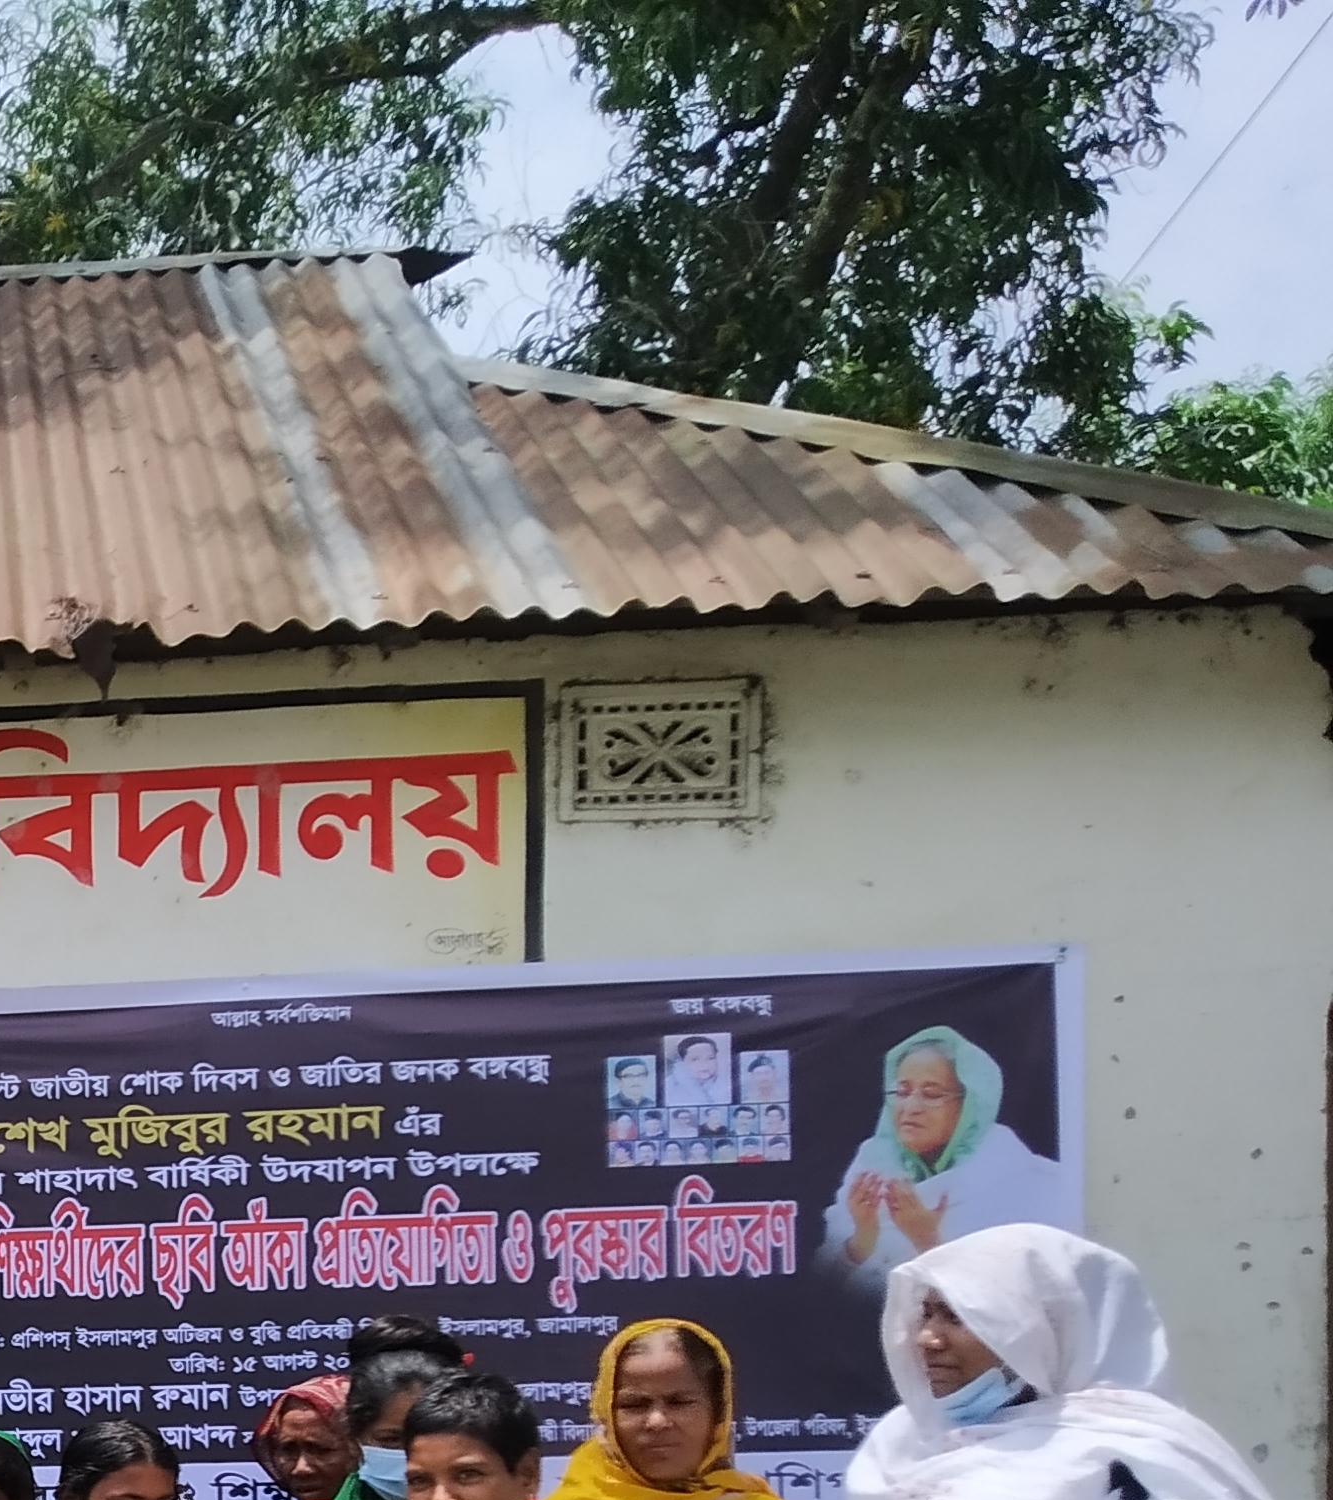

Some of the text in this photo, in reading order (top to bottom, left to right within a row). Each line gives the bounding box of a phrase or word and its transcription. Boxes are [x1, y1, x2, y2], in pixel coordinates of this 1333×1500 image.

[210, 1003, 352, 1028] আল্লাহ সর্বশক্তিমান
[669, 994, 773, 1017] জয় বঙ্গবন্ধু
[28, 1067, 111, 1100] জাতীয়
[119, 1068, 184, 1096] শোক
[191, 1062, 259, 1093] দিবস
[267, 1066, 291, 1088] ও
[298, 1055, 383, 1088] জাতির
[389, 1057, 460, 1084] জনক
[466, 1054, 552, 1085] বঙ্গবন্ধু
[82, 1104, 230, 1159] মুজিবুর
[242, 1103, 386, 1146] রহমান
[394, 1106, 444, 1137] এঁর
[14, 1165, 139, 1194] শাহাদাৎ
[144, 1153, 252, 1190] বার্ষিকী
[259, 1153, 399, 1184] উদযাপন
[405, 1148, 541, 1178] উপলক্ষে
[150, 1193, 218, 1309] ছবি
[221, 1197, 309, 1292] আঁকা
[313, 1184, 497, 1291] প্রতিযোগিতা
[501, 1209, 534, 1284] ও
[541, 1204, 668, 1313] পুরস্কার
[673, 1175, 798, 1280] বিতরণ
[10, 1326, 72, 1352] প্রশিপস্
[75, 1327, 157, 1350] ইসলামপুর
[161, 1322, 223, 1344] অটিজম
[228, 1327, 244, 1341] ও
[247, 1320, 282, 1346] বুদ্ধি
[286, 1317, 354, 1342] প্রতিবন্ধী
[437, 1316, 532, 1339] ইসলামপুর,
[535, 1315, 619, 1337] জামালপুর
[232, 1356, 259, 1373] ১৫
[261, 1350, 318, 1373] আগস্ট
[61, 1382, 144, 1416] হাসান
[150, 1381, 232, 1411] রুমান
[158, 1423, 238, 1450] আখন্দ
[742, 1415, 800, 1437] উপজেলা
